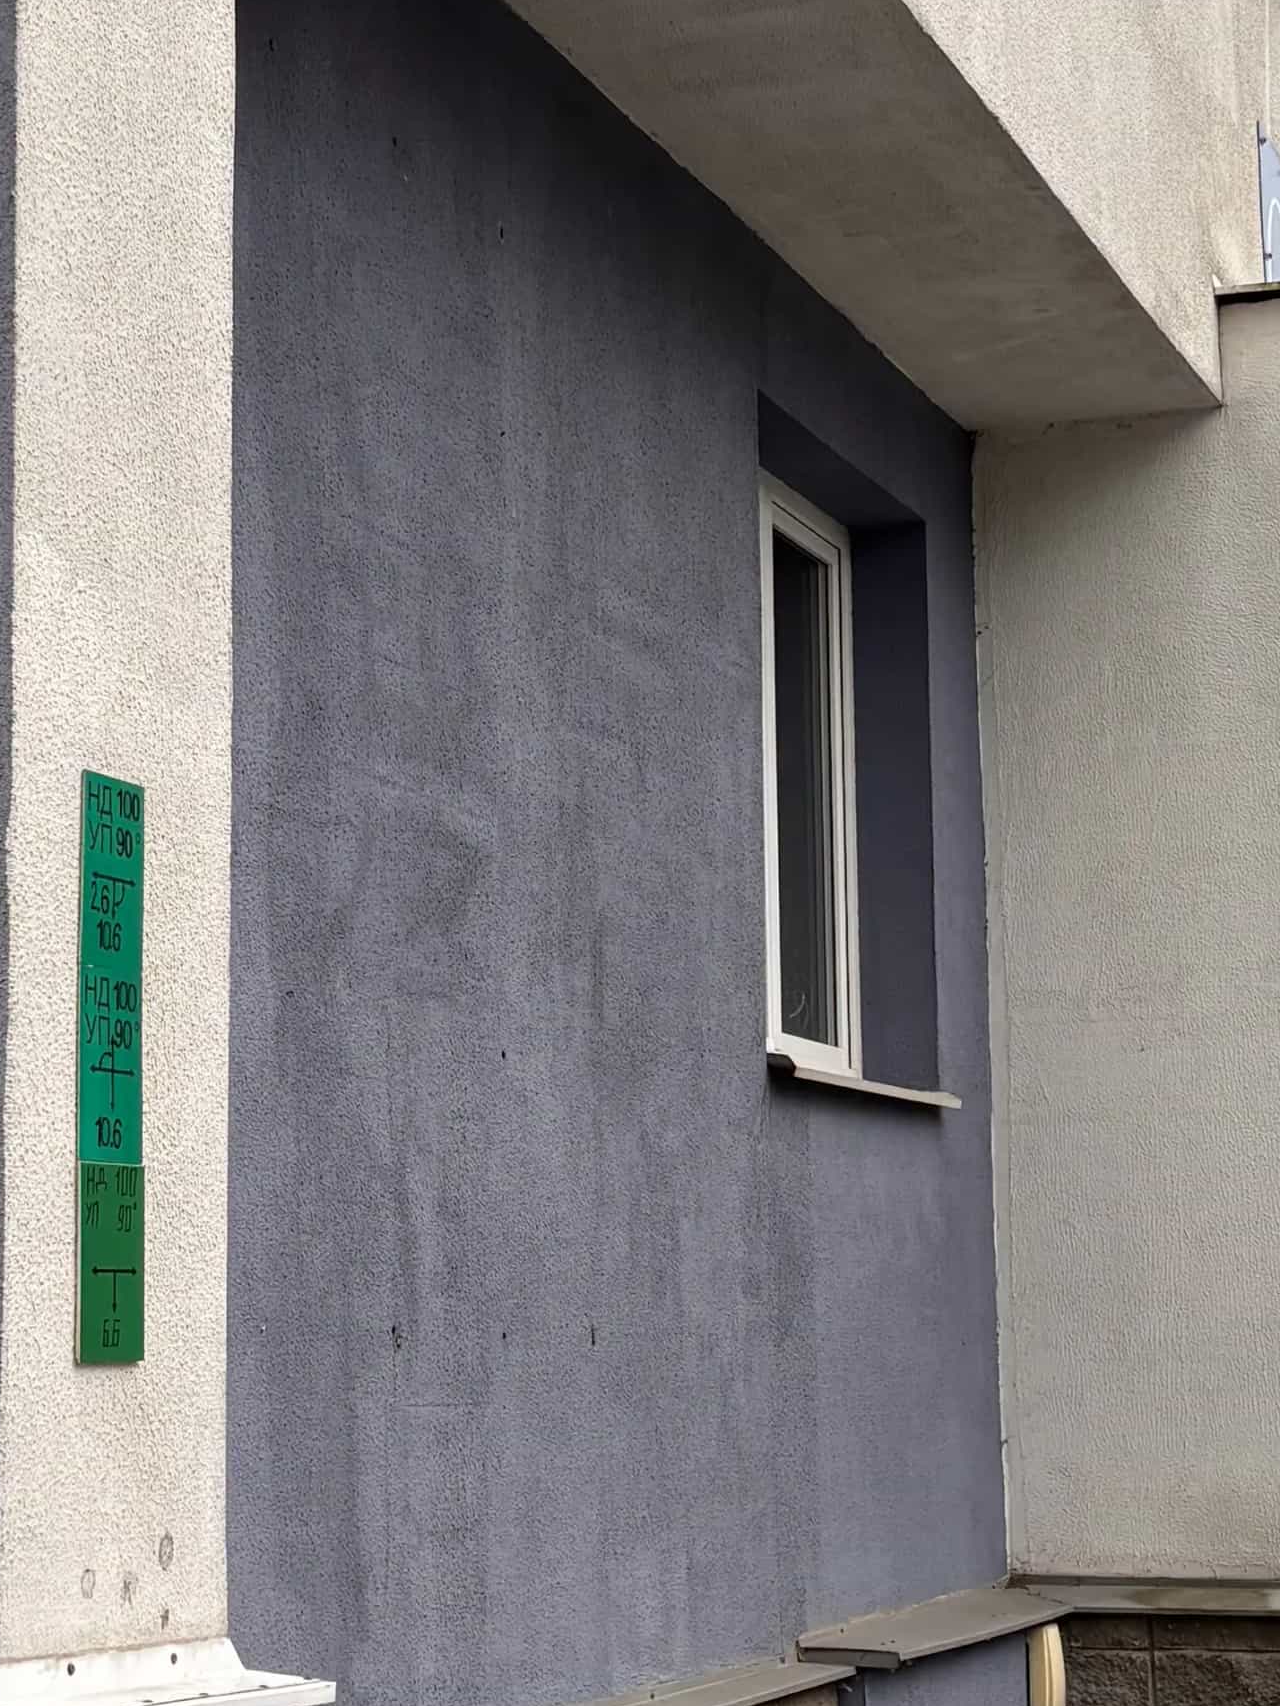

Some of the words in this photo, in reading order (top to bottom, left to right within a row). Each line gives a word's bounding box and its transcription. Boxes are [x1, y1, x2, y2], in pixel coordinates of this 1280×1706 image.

[87, 780, 113, 823] НД
[116, 788, 140, 822] 100
[87, 819, 112, 854] УП
[84, 974, 111, 1012] НД
[113, 979, 138, 1013] 100
[84, 1012, 110, 1046] УП
[95, 1116, 123, 1149] 10.6
[86, 1166, 108, 1197] НД
[115, 1165, 138, 1198] 100
